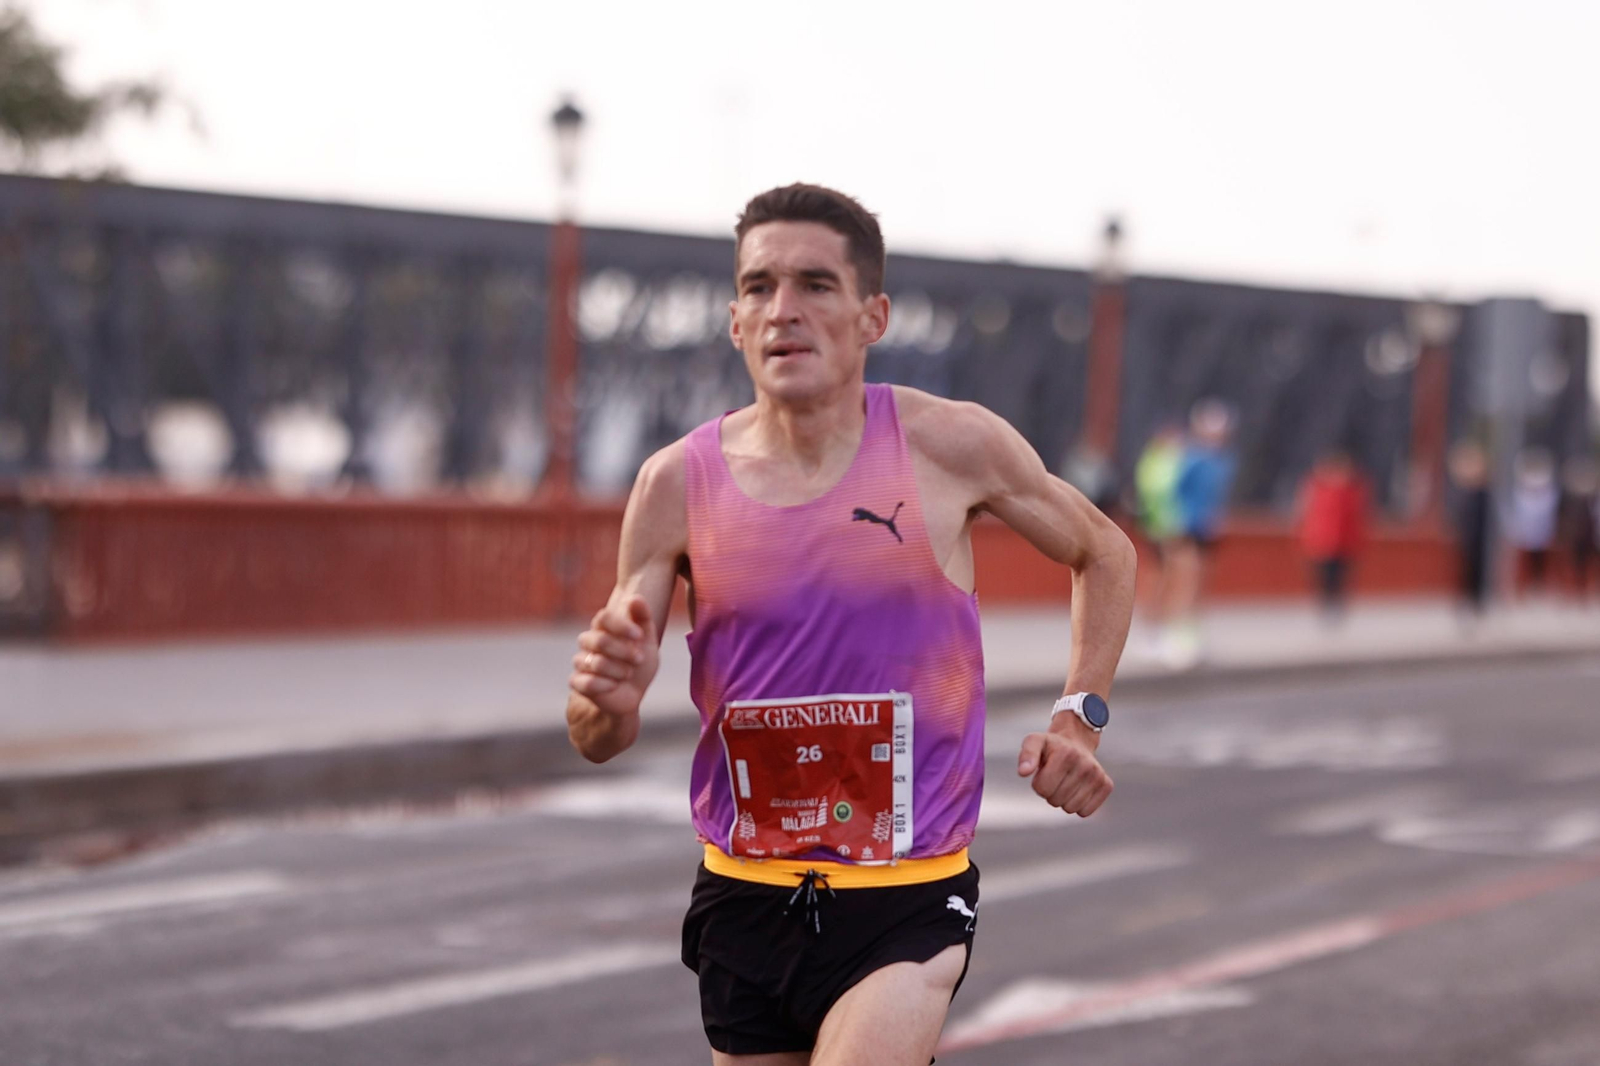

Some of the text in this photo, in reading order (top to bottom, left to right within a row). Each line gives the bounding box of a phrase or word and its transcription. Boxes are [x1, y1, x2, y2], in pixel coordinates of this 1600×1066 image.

[764, 702, 880, 728] GENERALI
[895, 733, 906, 754] BOX
[796, 745, 823, 763] 26
[895, 813, 906, 833] BOX
